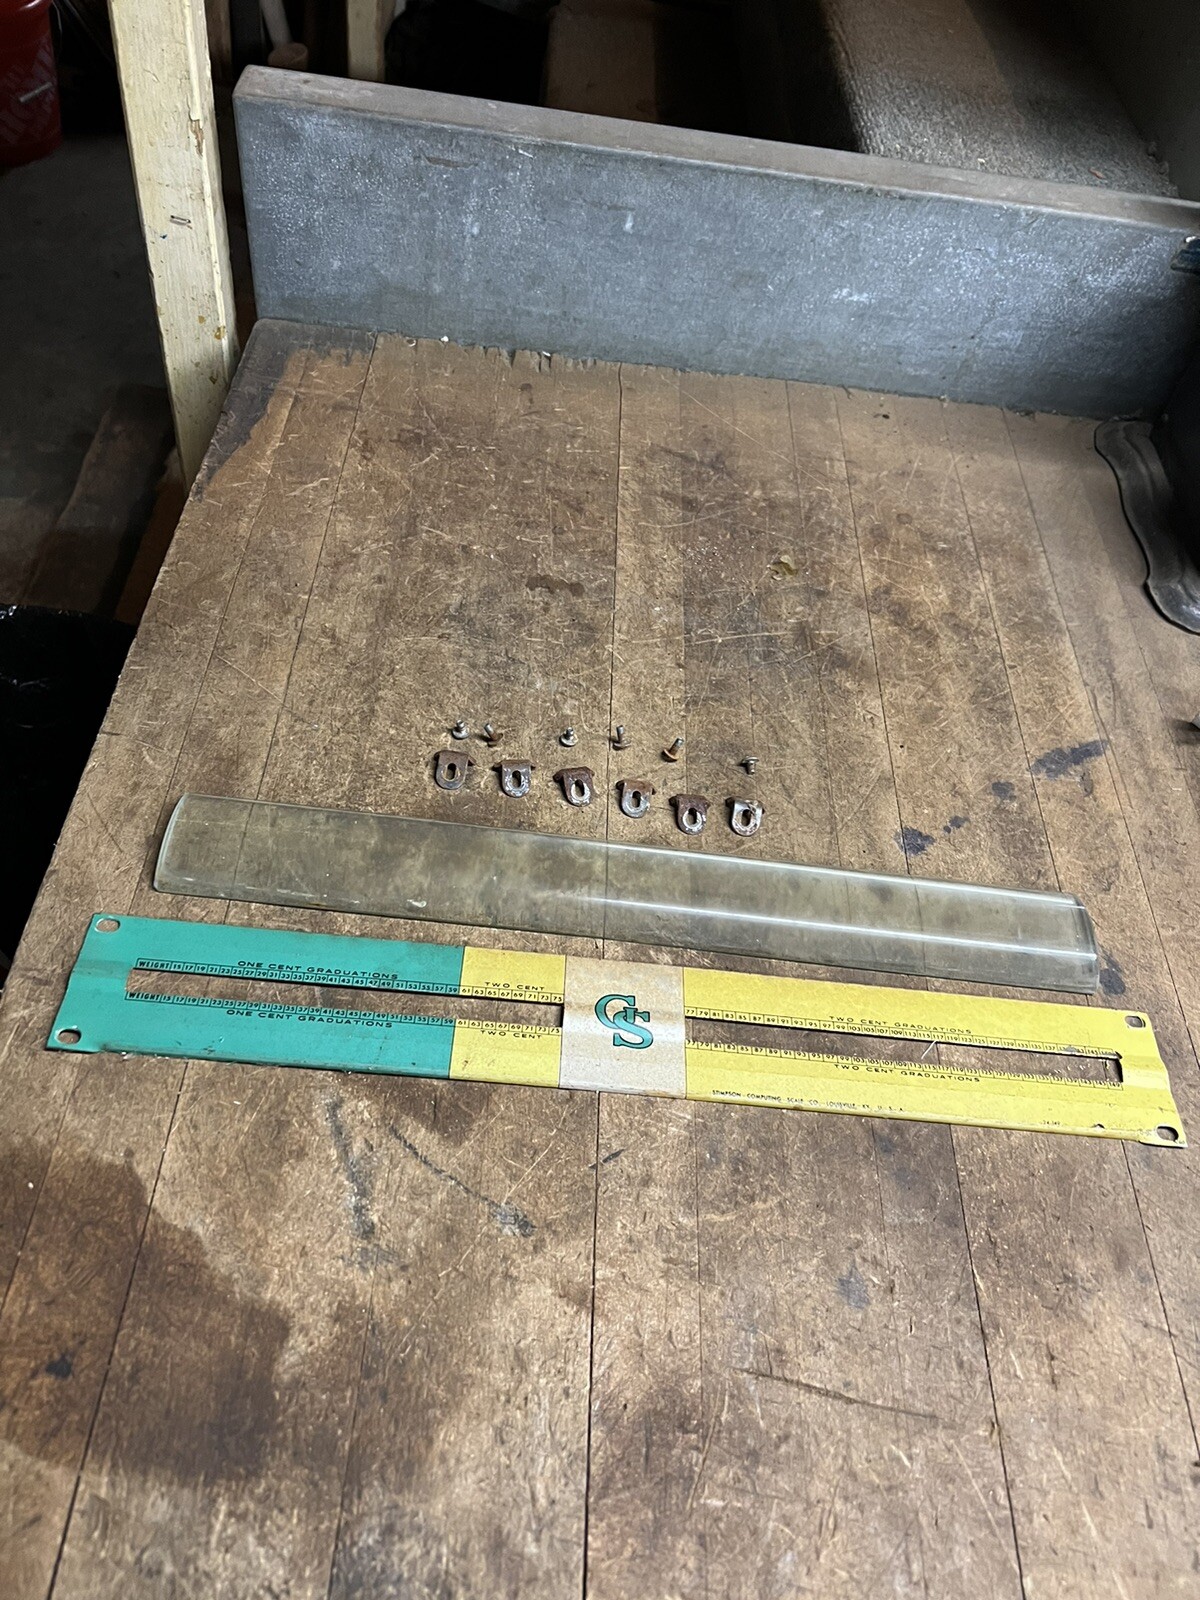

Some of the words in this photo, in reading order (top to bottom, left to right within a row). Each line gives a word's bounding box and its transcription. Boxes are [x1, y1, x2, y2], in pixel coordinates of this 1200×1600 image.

[138, 960, 170, 970] WEIGHT
[268, 963, 302, 971] CENT
[306, 966, 398, 980] GRADUATIONS
[128, 992, 161, 1000] WEIGHT
[226, 1009, 253, 1017] ONE
[257, 1012, 292, 1020] CENT
[298, 1016, 393, 1028] GRADUATIONS
[894, 1022, 972, 1034] GRADUATIONS
[900, 1070, 981, 1082] GRADUATIONS
[746, 1093, 782, 1102] COMPUTING
